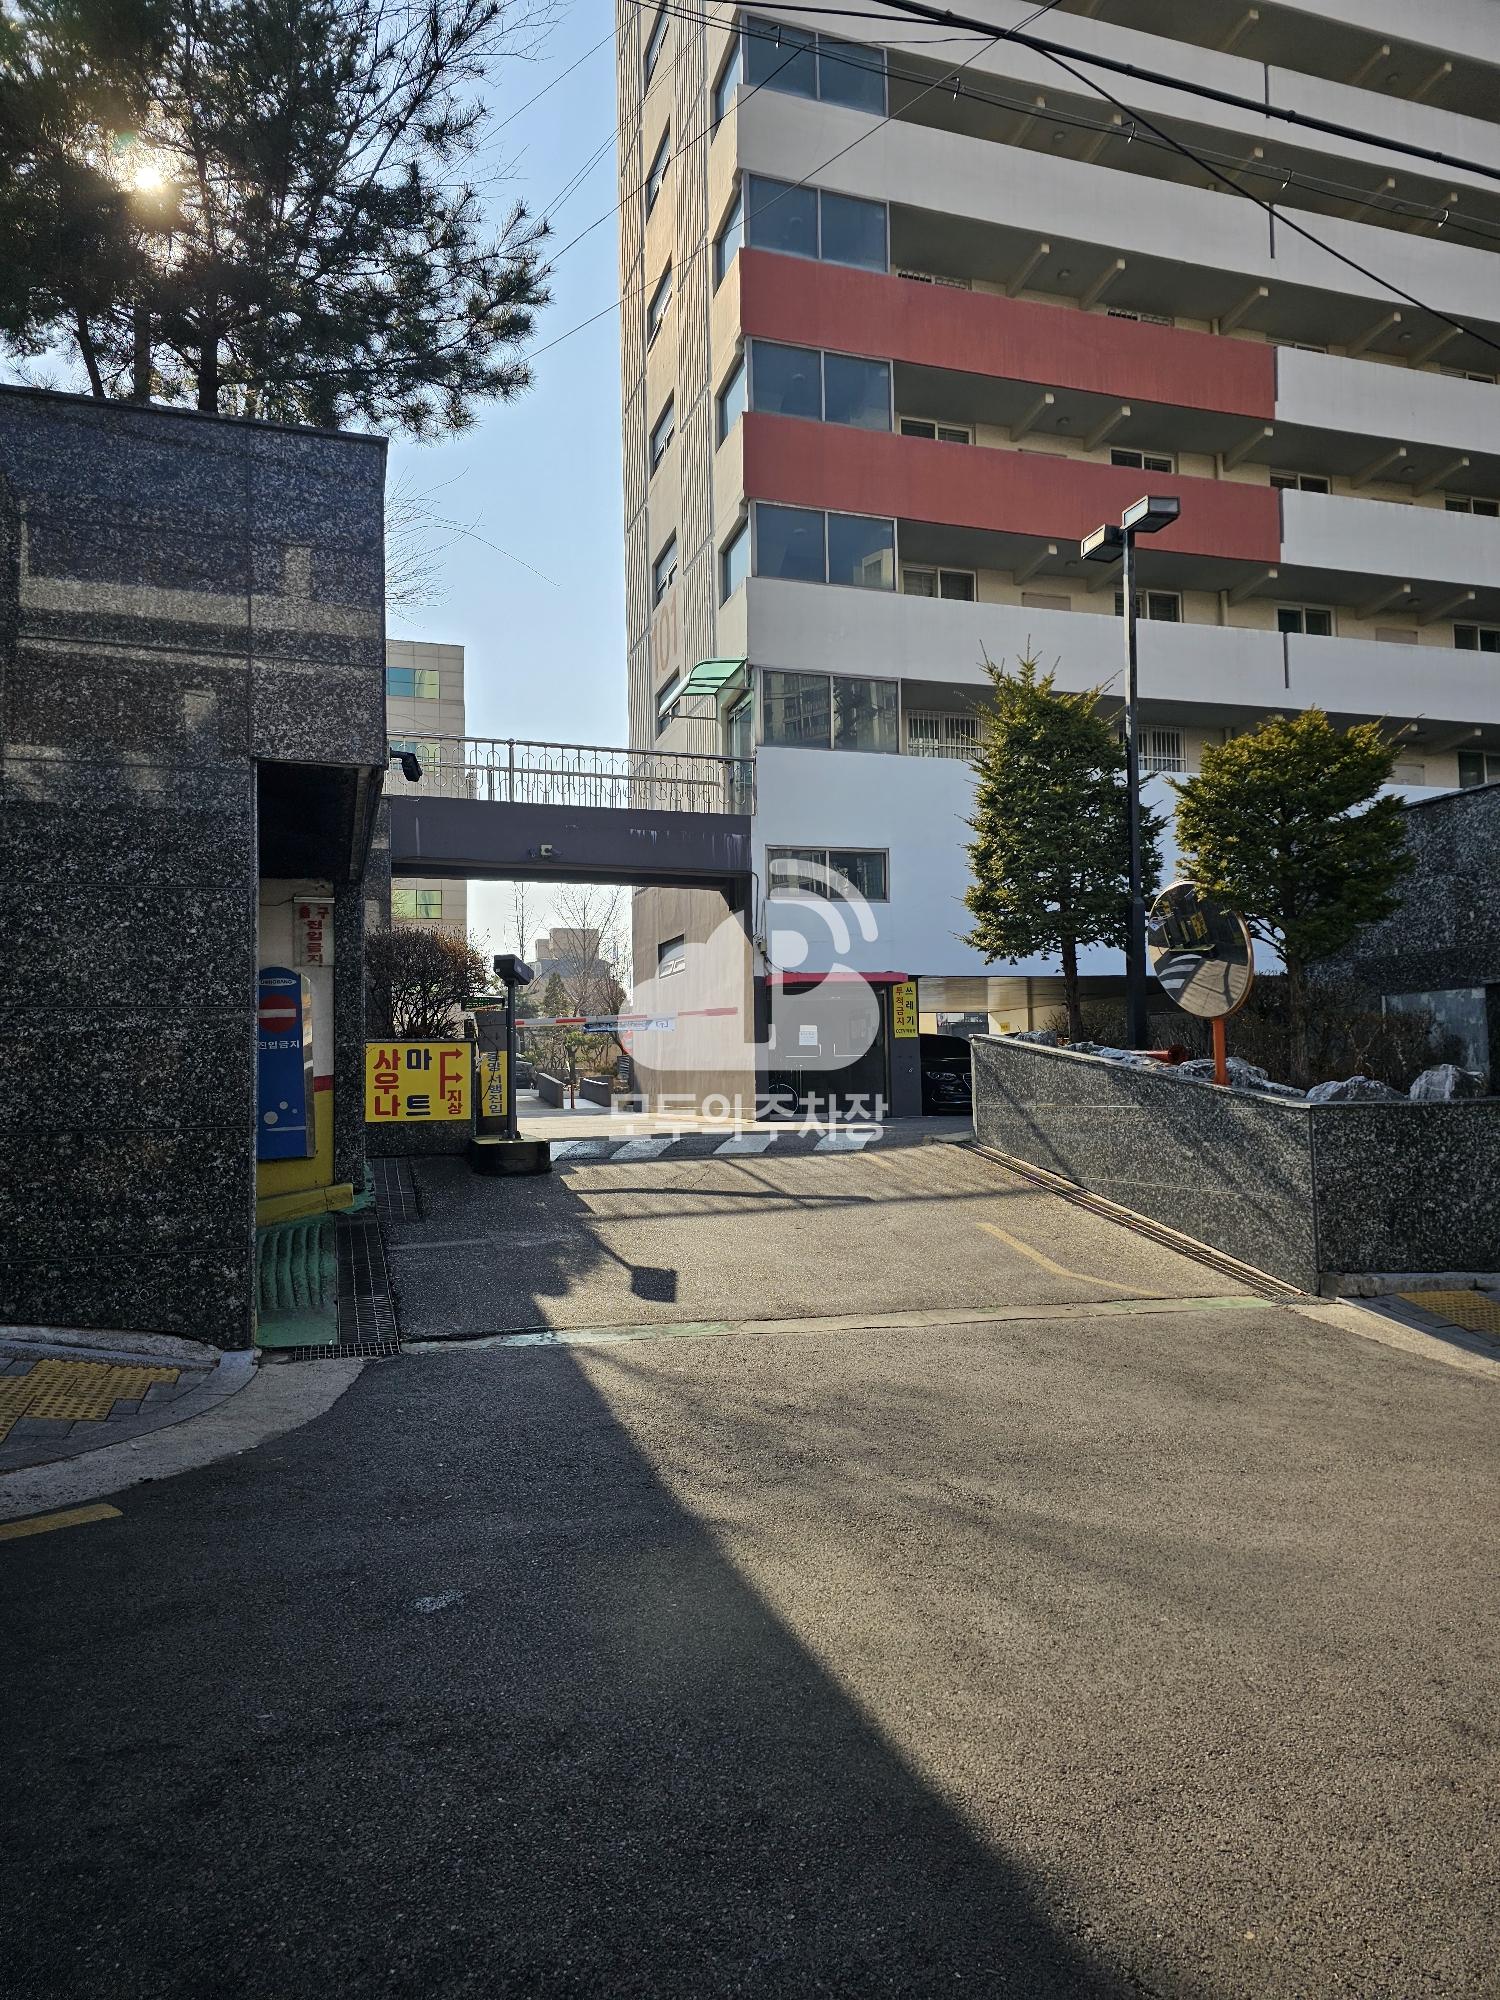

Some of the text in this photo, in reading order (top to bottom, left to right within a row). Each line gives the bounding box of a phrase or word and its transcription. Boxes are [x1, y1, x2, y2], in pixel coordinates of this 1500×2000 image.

[306, 920, 323, 964] 진입금지
[905, 986, 914, 1026] 쓰레기
[258, 1039, 300, 1050] 진입금지
[373, 1048, 402, 1117] 사우나
[405, 1048, 433, 1117] 마트
[447, 1089, 463, 1115] 지상
